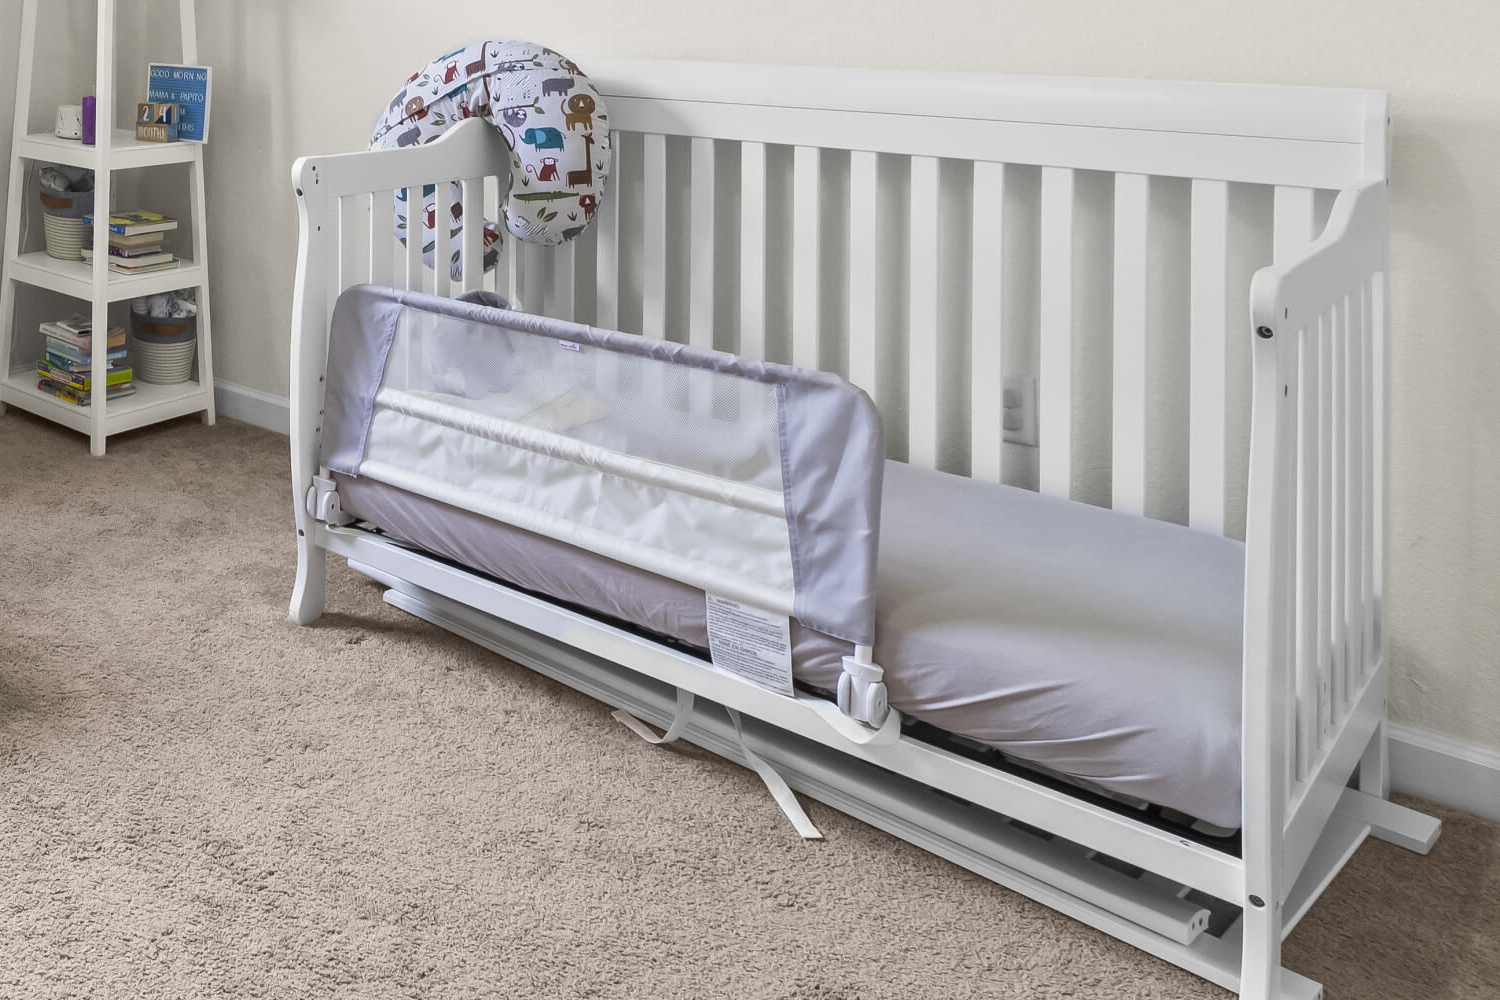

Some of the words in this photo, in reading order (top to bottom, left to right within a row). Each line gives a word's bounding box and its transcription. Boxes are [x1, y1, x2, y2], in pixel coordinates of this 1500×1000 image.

[150, 69, 170, 79] GOOD
[173, 71, 207, 81] MORNNG
[149, 90, 169, 99] MAMA
[180, 92, 204, 102] PAPITO
